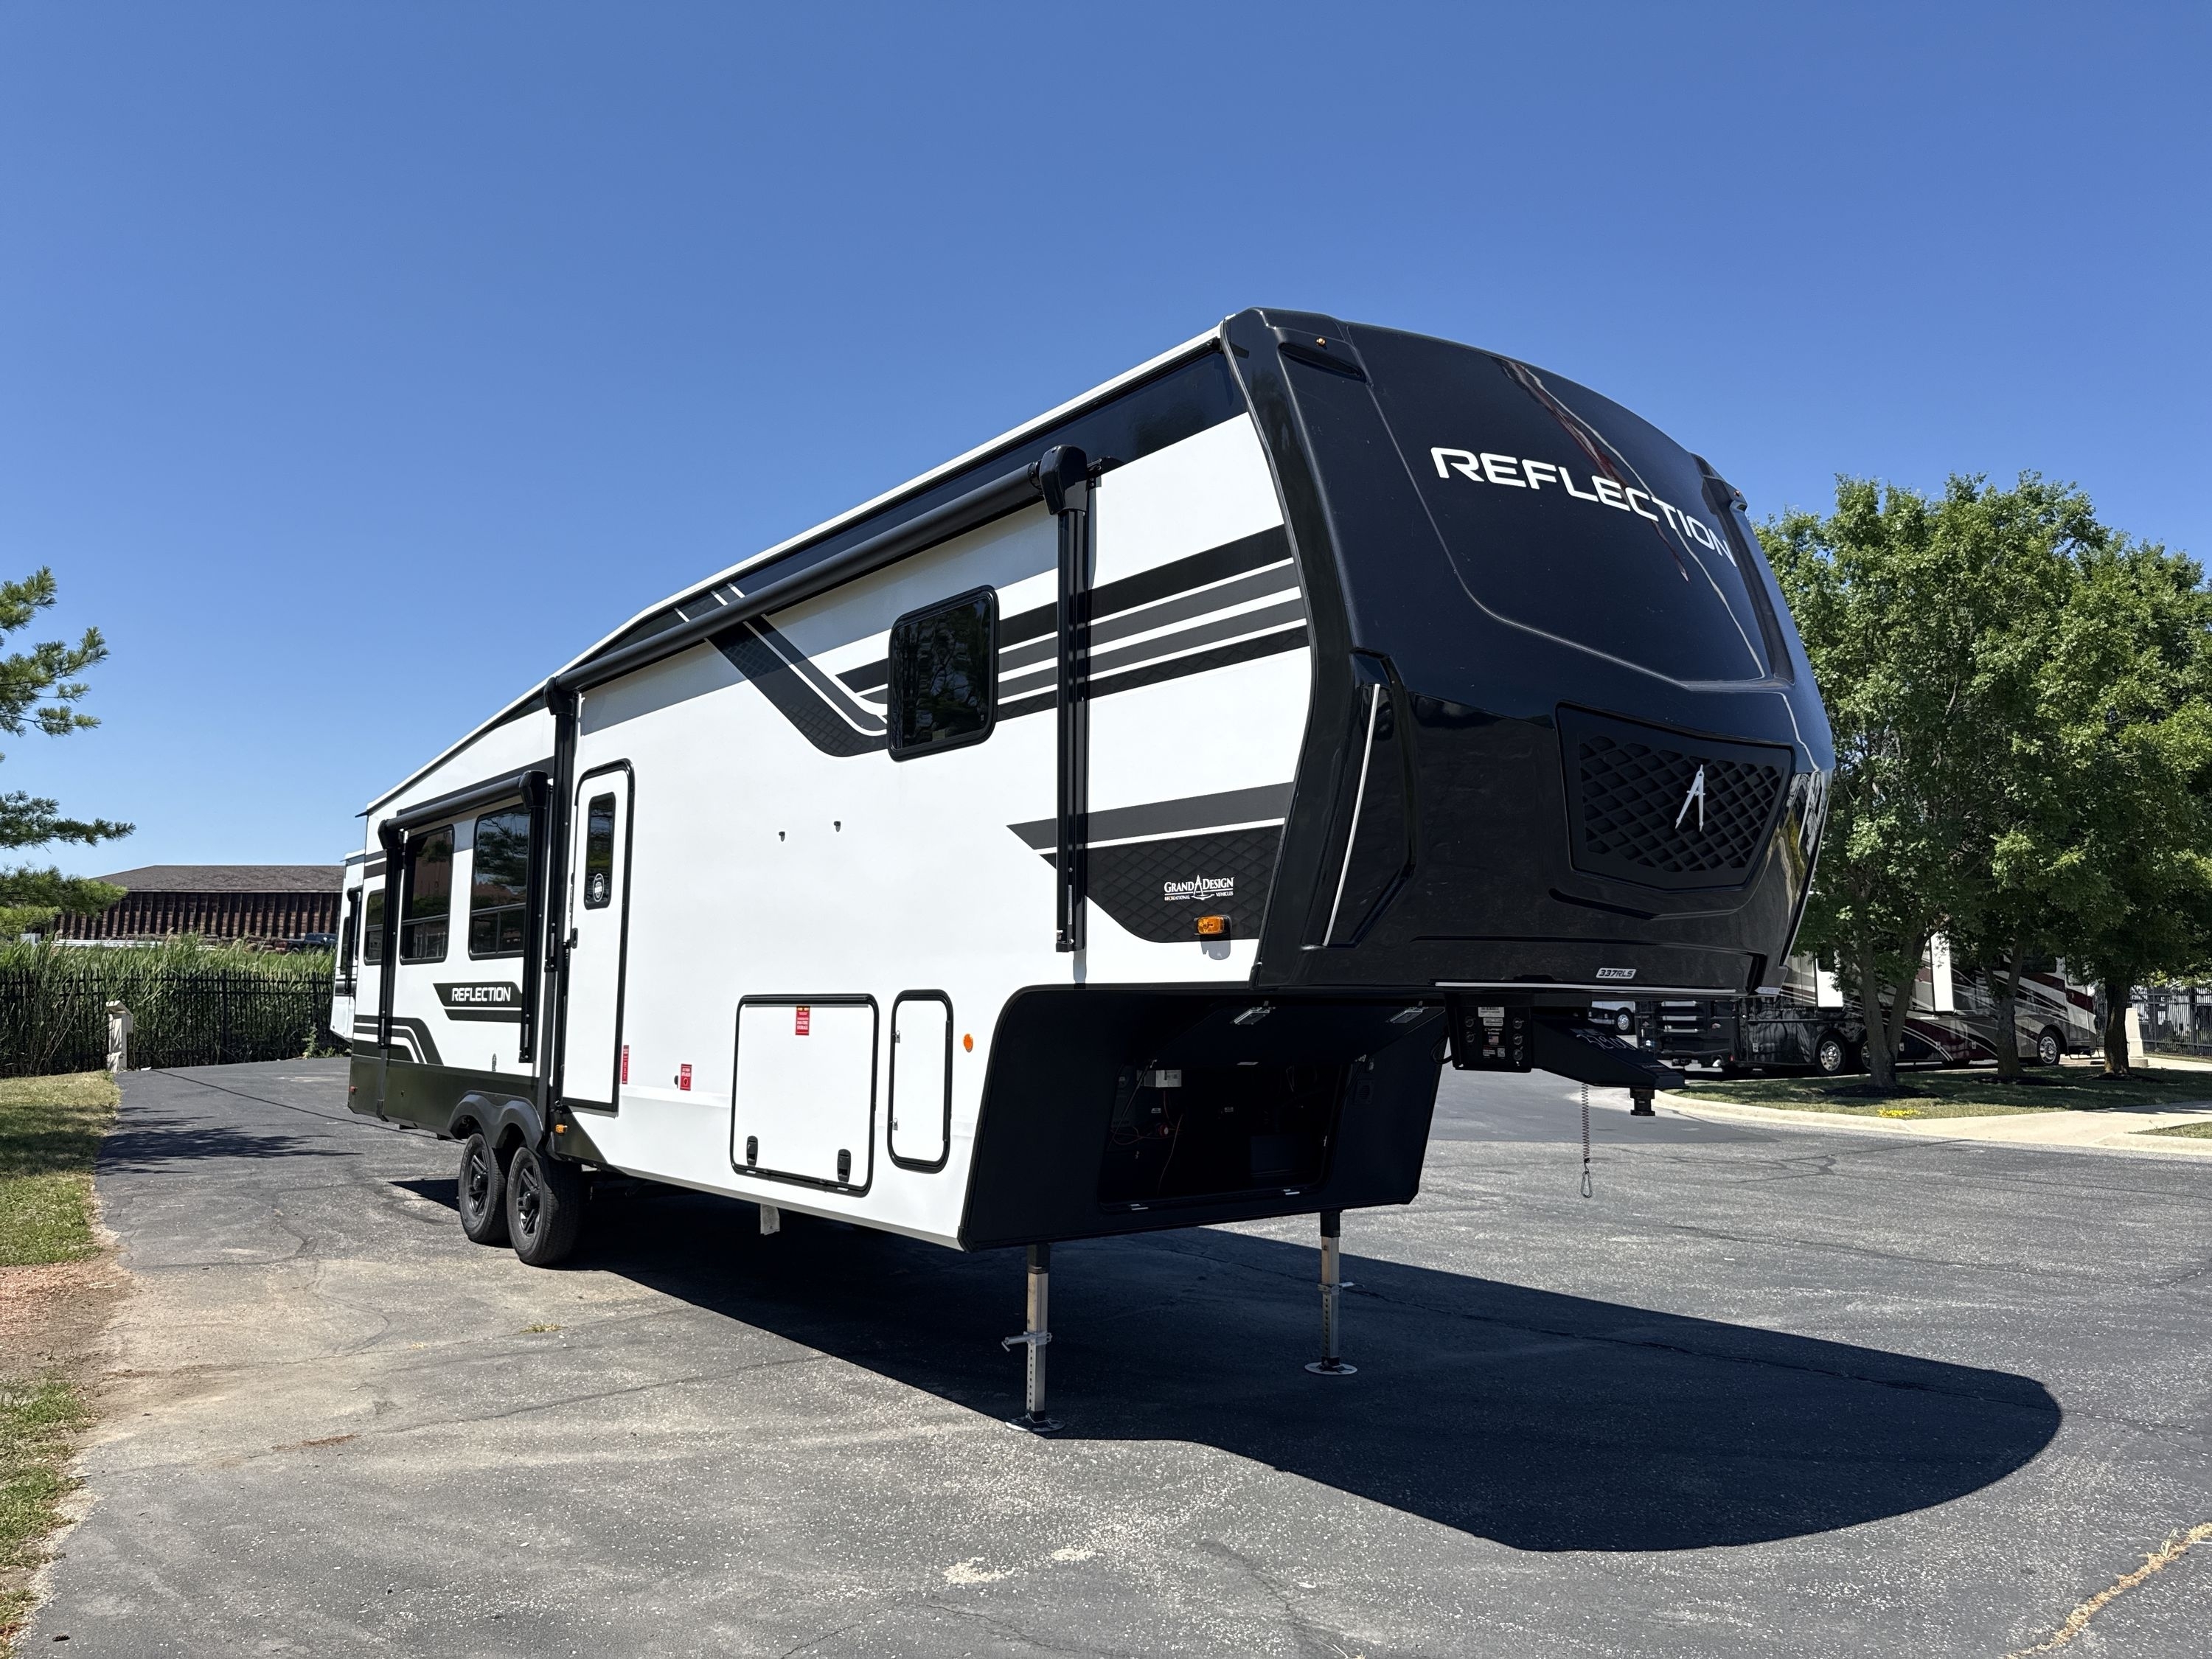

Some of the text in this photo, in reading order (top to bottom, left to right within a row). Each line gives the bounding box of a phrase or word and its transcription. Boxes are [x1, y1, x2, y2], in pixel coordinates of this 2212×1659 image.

[1430, 447, 1737, 567] REFLECTION
[1164, 877, 1234, 892] GRAND DESIGN
[1599, 969, 1633, 978] 337RLS
[451, 987, 511, 1002] REFLECTION
